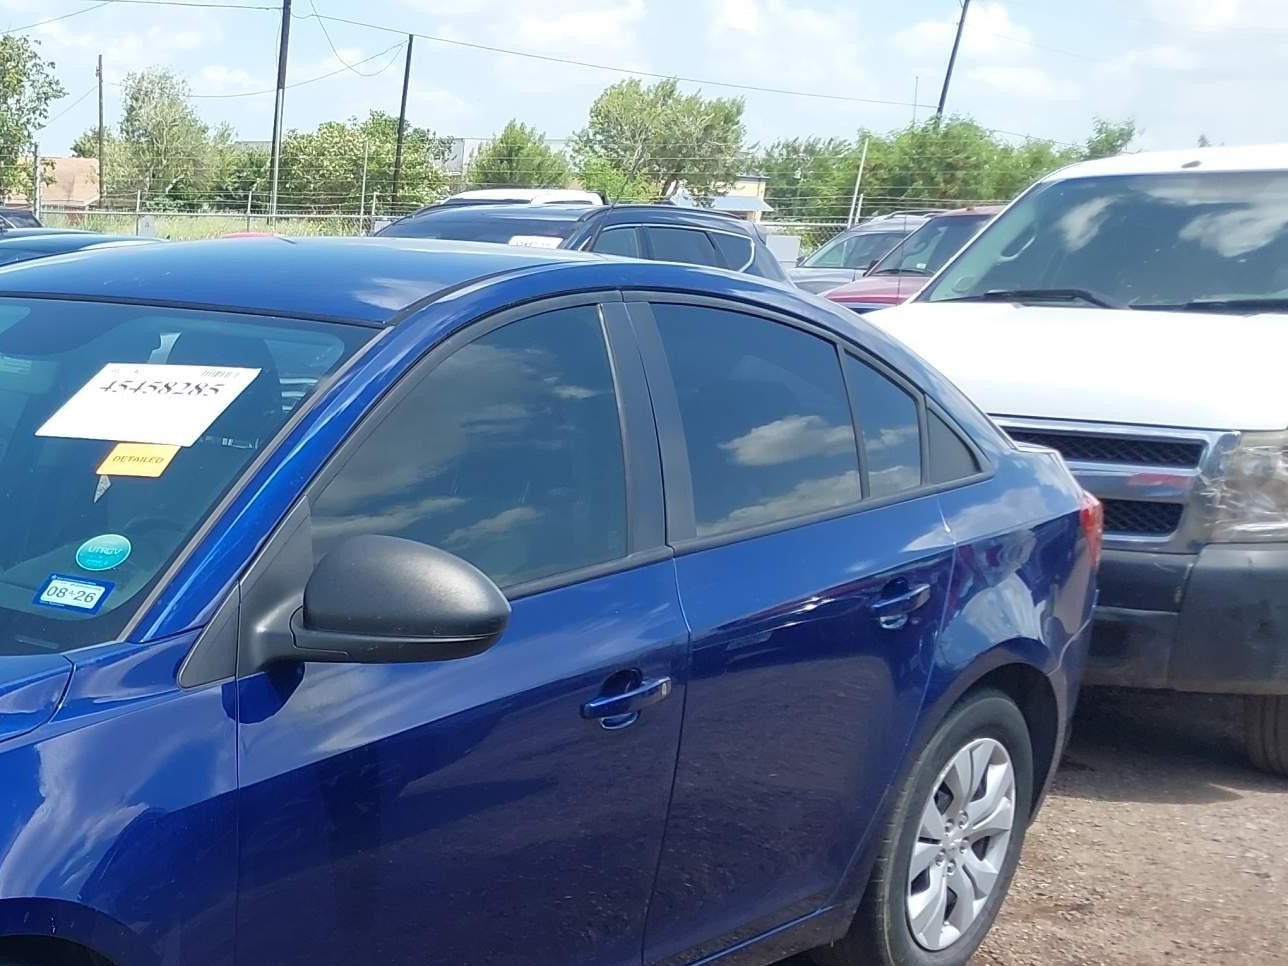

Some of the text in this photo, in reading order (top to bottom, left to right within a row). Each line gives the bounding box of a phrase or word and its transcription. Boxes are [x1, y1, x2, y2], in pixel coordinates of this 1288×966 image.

[99, 379, 225, 397] 45458285
[112, 454, 164, 465] DETAILED
[46, 585, 69, 599] 08
[73, 590, 97, 603] 26
